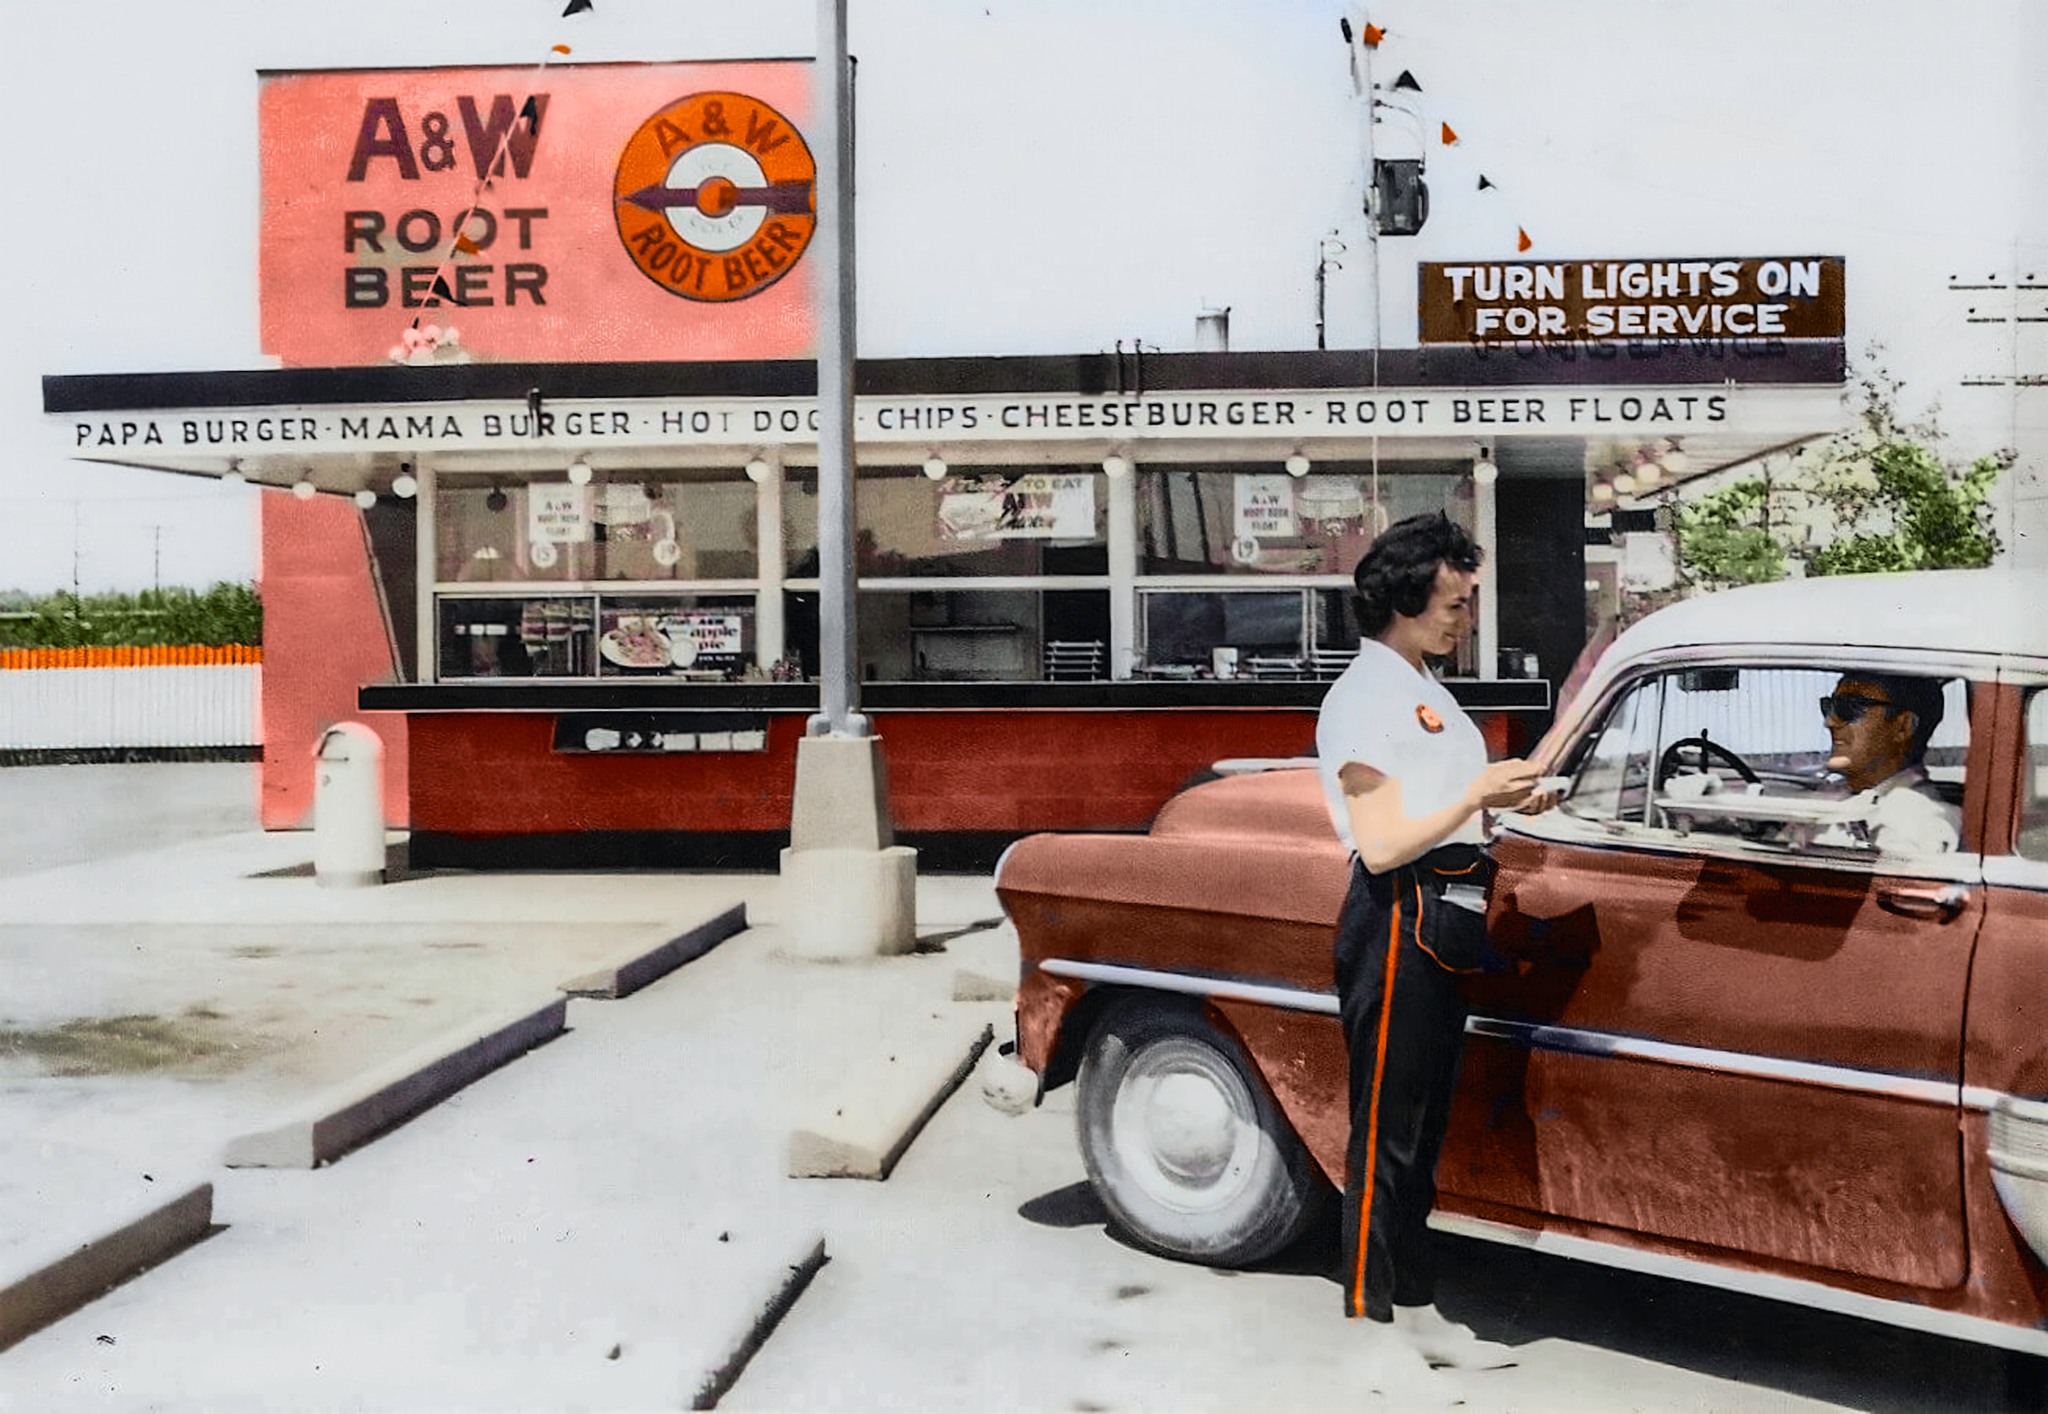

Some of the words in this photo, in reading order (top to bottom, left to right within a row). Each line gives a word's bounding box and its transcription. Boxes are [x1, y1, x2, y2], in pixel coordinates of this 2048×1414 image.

[347, 93, 551, 182] A&W
[344, 207, 548, 254] ROOT
[632, 222, 711, 291] ROOT
[723, 221, 801, 292] BEER
[345, 262, 548, 309] BEER
[1443, 264, 1565, 301] TURN
[1581, 261, 1741, 299] LIGHTS
[1756, 261, 1821, 297] ON
[1475, 307, 1567, 336] FOR
[1585, 303, 1789, 335] SERVICE
[76, 421, 163, 447] PAPA
[182, 418, 318, 444] BURGER
[340, 415, 463, 441] MAMA
[483, 411, 631, 437] BURGER
[661, 410, 733, 433] HOT
[876, 406, 978, 430] CHIPS
[1327, 400, 1430, 424] ROOT
[1452, 399, 1546, 424] BEER
[1569, 396, 1727, 422] FLOATS
[1051, 477, 1085, 490] EAT
[690, 625, 738, 639] apple
[698, 641, 725, 651] pie
